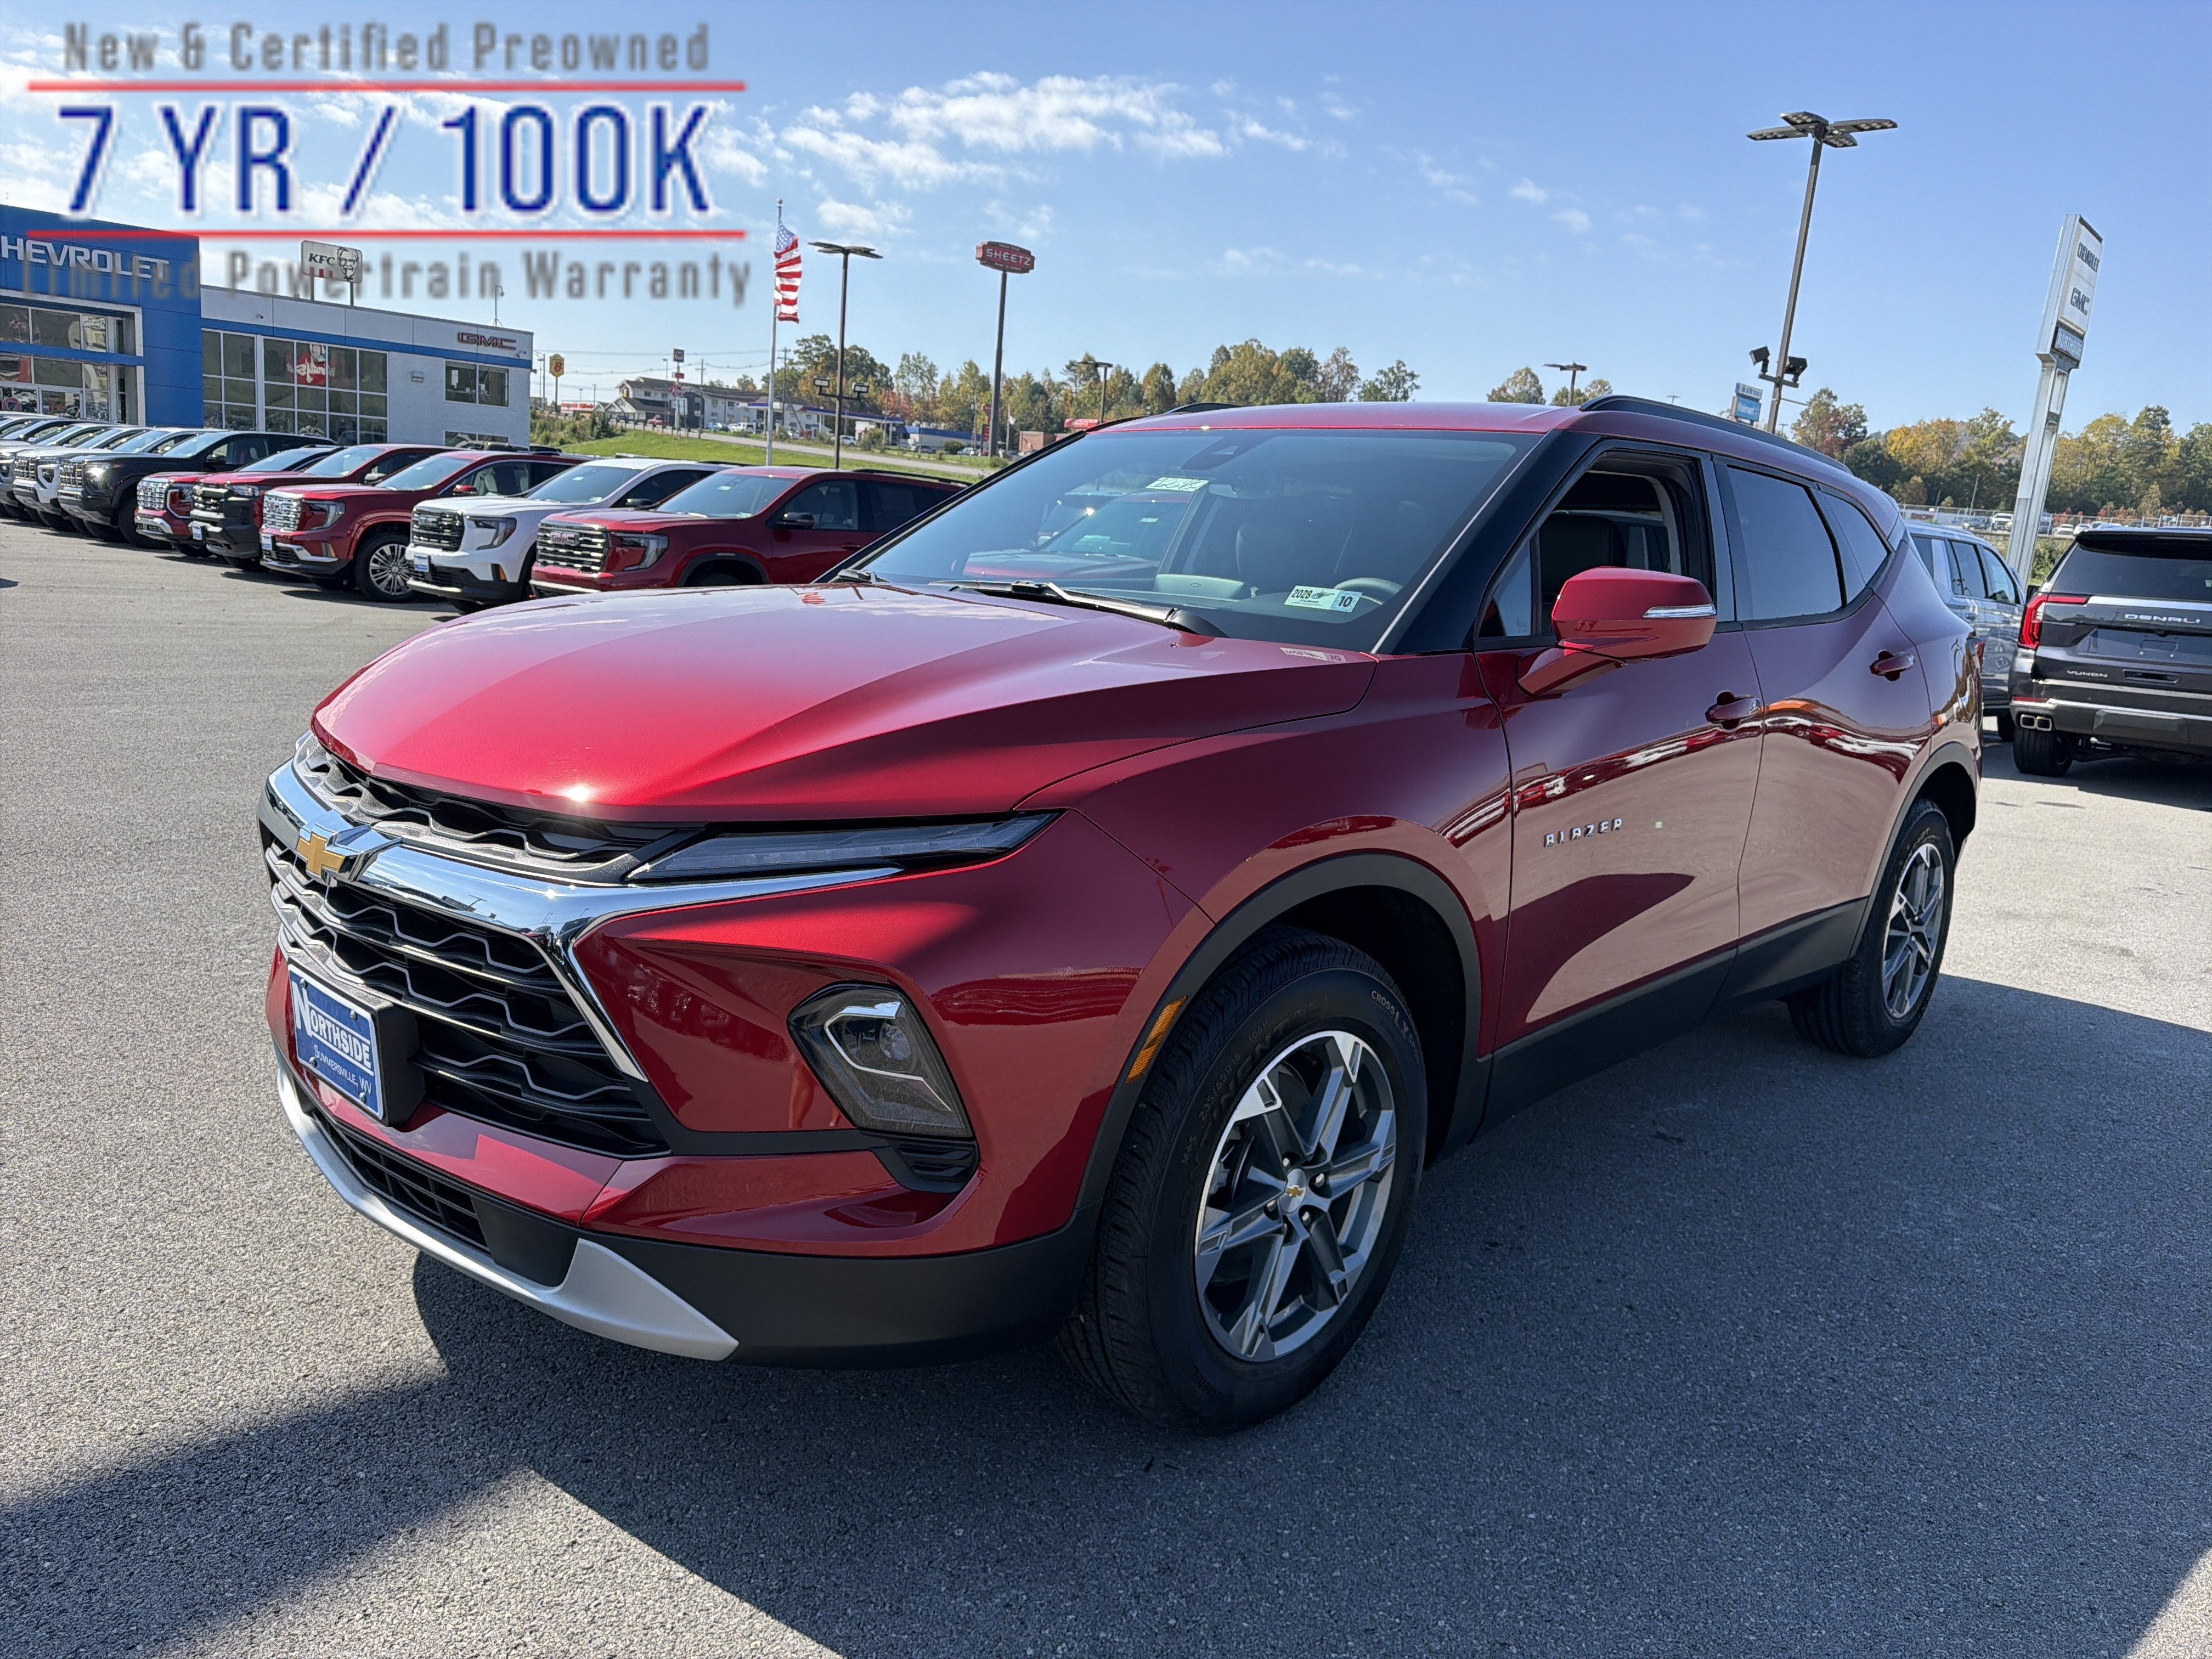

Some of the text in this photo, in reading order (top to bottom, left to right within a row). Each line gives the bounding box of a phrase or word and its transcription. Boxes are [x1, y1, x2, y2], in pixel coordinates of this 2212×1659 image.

[307, 252, 336, 266] KFC
[986, 248, 1031, 266] SHEETZ
[2070, 287, 2091, 317] GMC
[458, 331, 517, 351] GMC
[550, 531, 575, 545] GMC
[1291, 588, 1313, 599] 2028
[1338, 595, 1353, 607] 10
[2124, 613, 2200, 624] DENALI
[2066, 669, 2108, 678] YUKON
[1543, 817, 1623, 848] BLAZER
[1370, 989, 1397, 1015] CROSS
[291, 980, 372, 1069] NORTHSIDE
[313, 1044, 373, 1095] SUMMERSVILLE, WV
